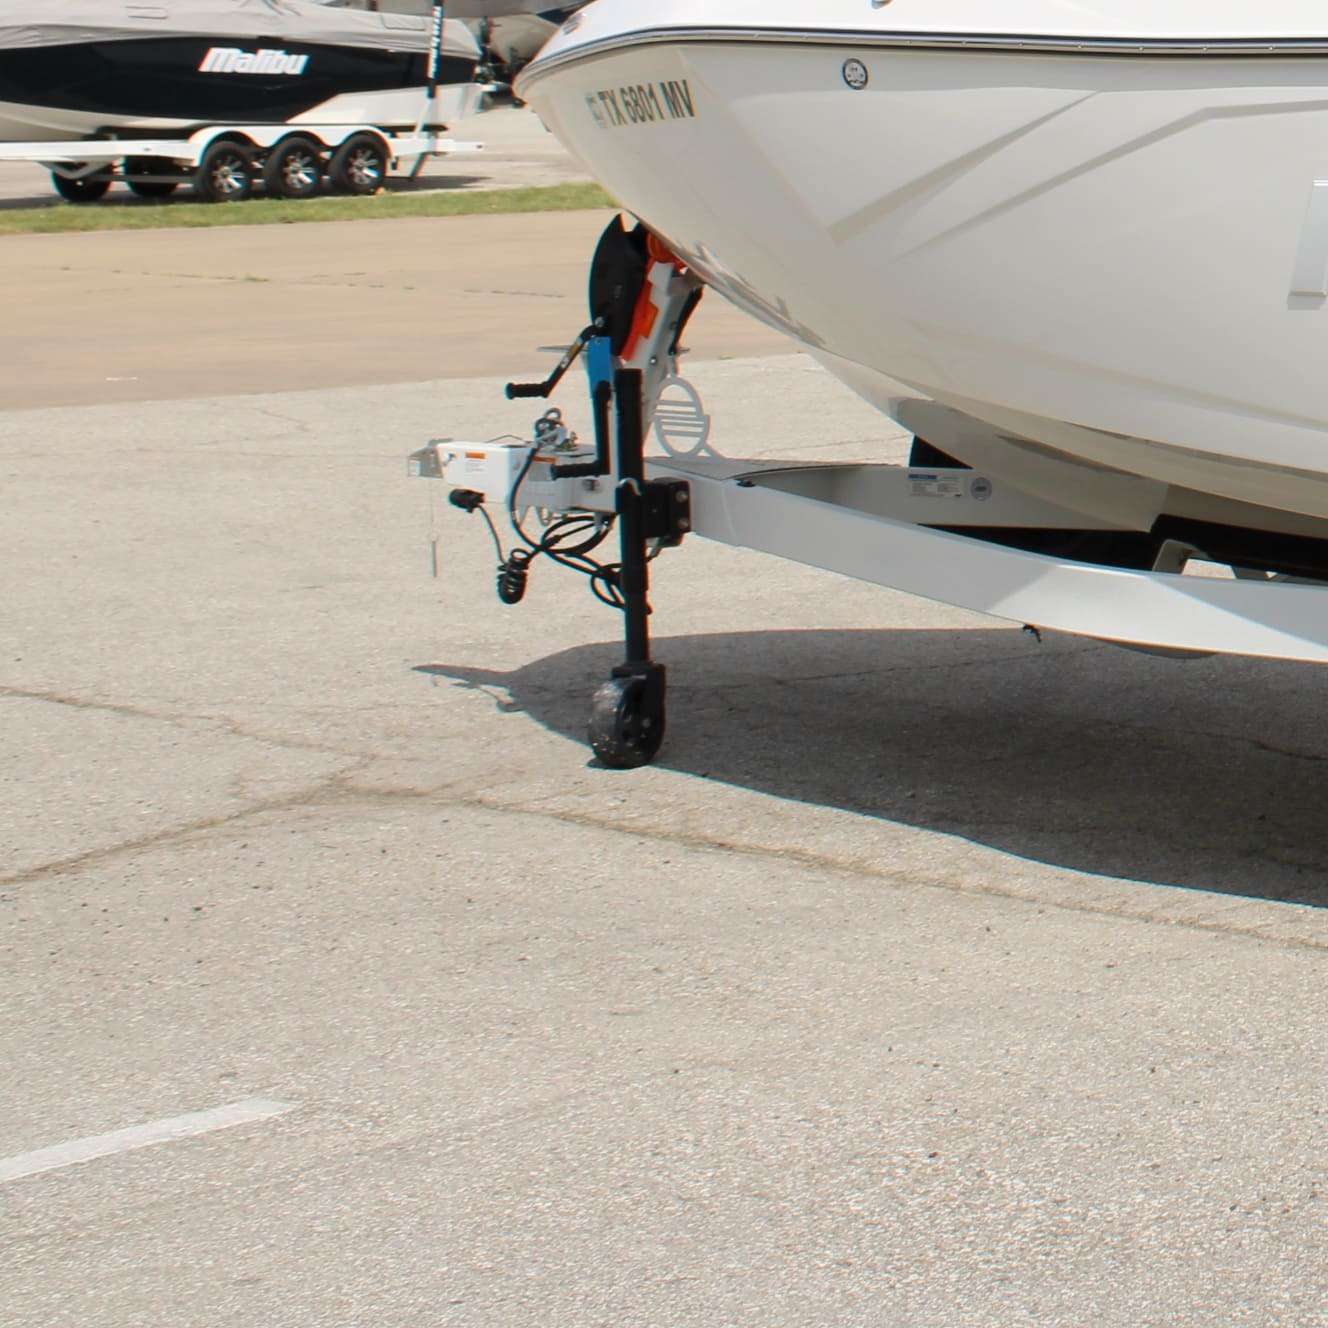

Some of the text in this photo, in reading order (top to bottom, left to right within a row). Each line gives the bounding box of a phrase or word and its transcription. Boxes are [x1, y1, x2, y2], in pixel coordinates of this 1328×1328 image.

[199, 47, 310, 75] Malibu
[597, 88, 628, 126] TX
[620, 82, 665, 124] 6801
[659, 79, 695, 119] MV
